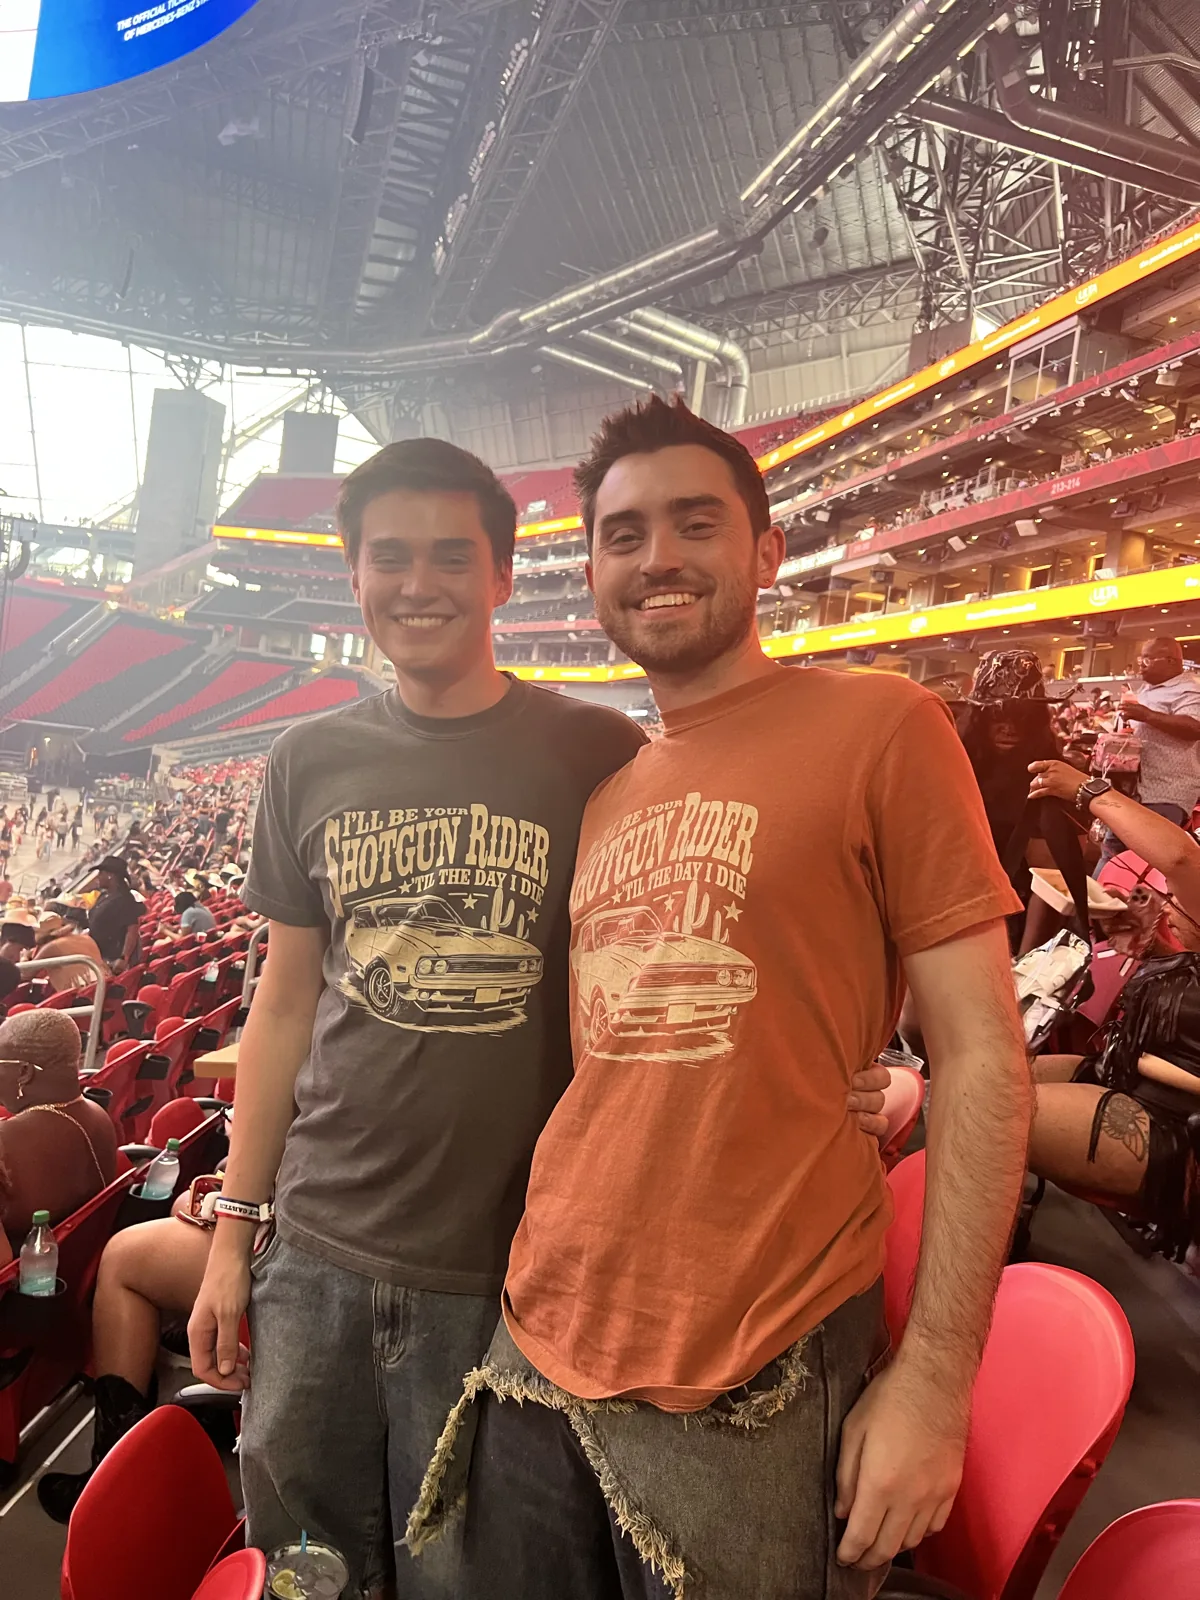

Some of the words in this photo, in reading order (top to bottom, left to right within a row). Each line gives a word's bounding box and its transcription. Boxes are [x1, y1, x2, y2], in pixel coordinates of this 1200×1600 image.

[117, 17, 132, 31] THE
[132, 3, 166, 26] OFFICIAL
[124, 28, 136, 41] OF
[342, 810, 383, 837] I'LL
[388, 809, 418, 827] BE
[424, 807, 468, 818] YOUR
[619, 809, 642, 832] BE
[646, 800, 683, 817] YOUR
[668, 792, 759, 875] RIDER
[324, 816, 461, 918] SHOTGUN
[465, 803, 549, 887] RIDER
[439, 869, 470, 885] THE
[474, 869, 506, 888] DAY
[510, 875, 517, 891] I
[520, 877, 545, 905] DIE
[647, 865, 672, 891] THE
[673, 861, 703, 882] DAY
[704, 862, 712, 883] I
[715, 864, 747, 900] DIE
